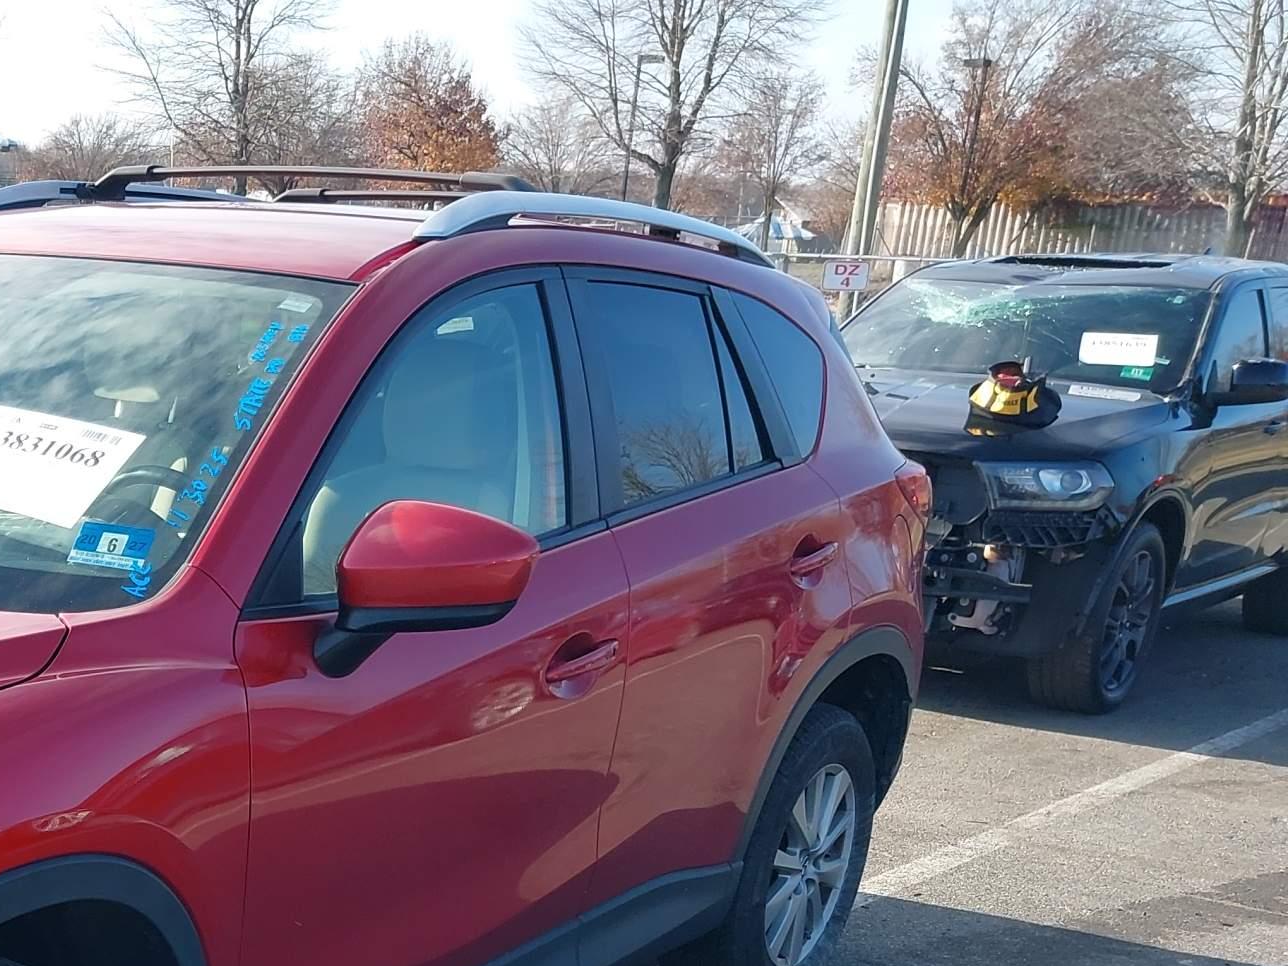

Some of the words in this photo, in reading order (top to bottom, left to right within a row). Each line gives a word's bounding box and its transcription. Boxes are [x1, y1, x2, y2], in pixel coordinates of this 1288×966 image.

[834, 264, 860, 276] DZ
[840, 277, 850, 288] 4
[79, 534, 98, 545] 20
[106, 537, 118, 553] 6
[128, 541, 147, 552] 27
